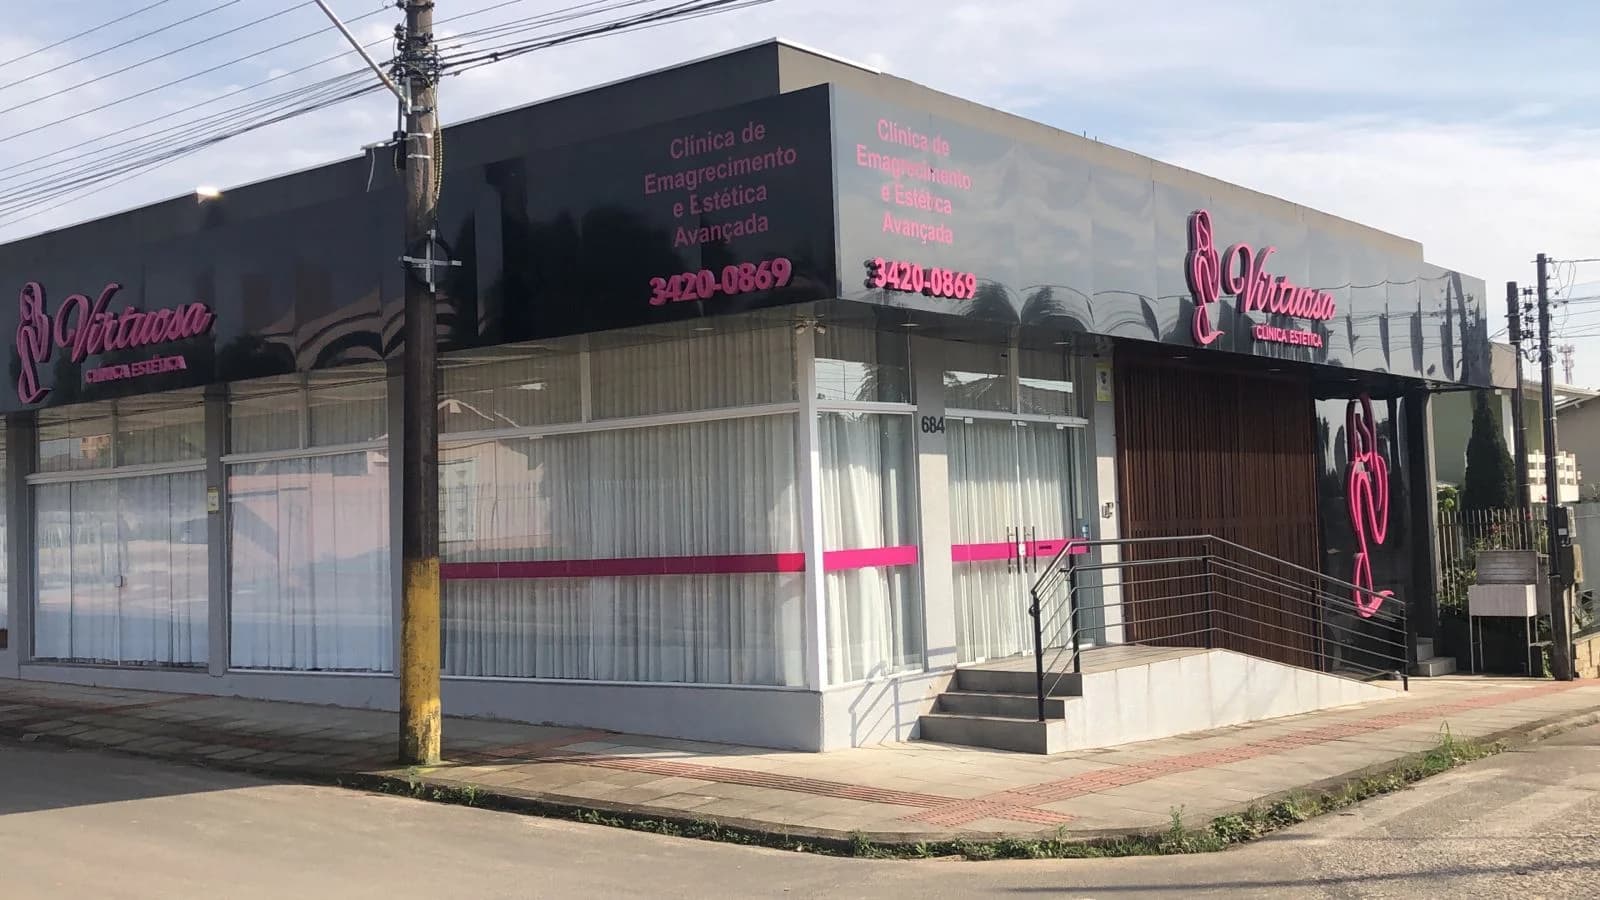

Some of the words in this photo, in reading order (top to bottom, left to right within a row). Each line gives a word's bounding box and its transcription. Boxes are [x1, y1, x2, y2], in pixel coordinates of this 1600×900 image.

[670, 130, 735, 160] Clínica
[742, 120, 766, 144] de
[932, 134, 951, 157] de
[644, 147, 798, 195] Emagrecimento
[856, 143, 973, 190] Emagrecimento
[673, 202, 684, 218] e
[689, 184, 768, 216] Estética
[880, 184, 891, 201] e
[894, 183, 953, 214] Estética
[673, 212, 769, 248] Avançada
[882, 211, 953, 245] Avançada
[649, 257, 793, 306] 3420-0869
[870, 256, 977, 299] 3420-0869
[1223, 242, 1337, 320] Virtuosa
[54, 283, 213, 363] Virtuosa
[921, 415, 945, 434] 684
